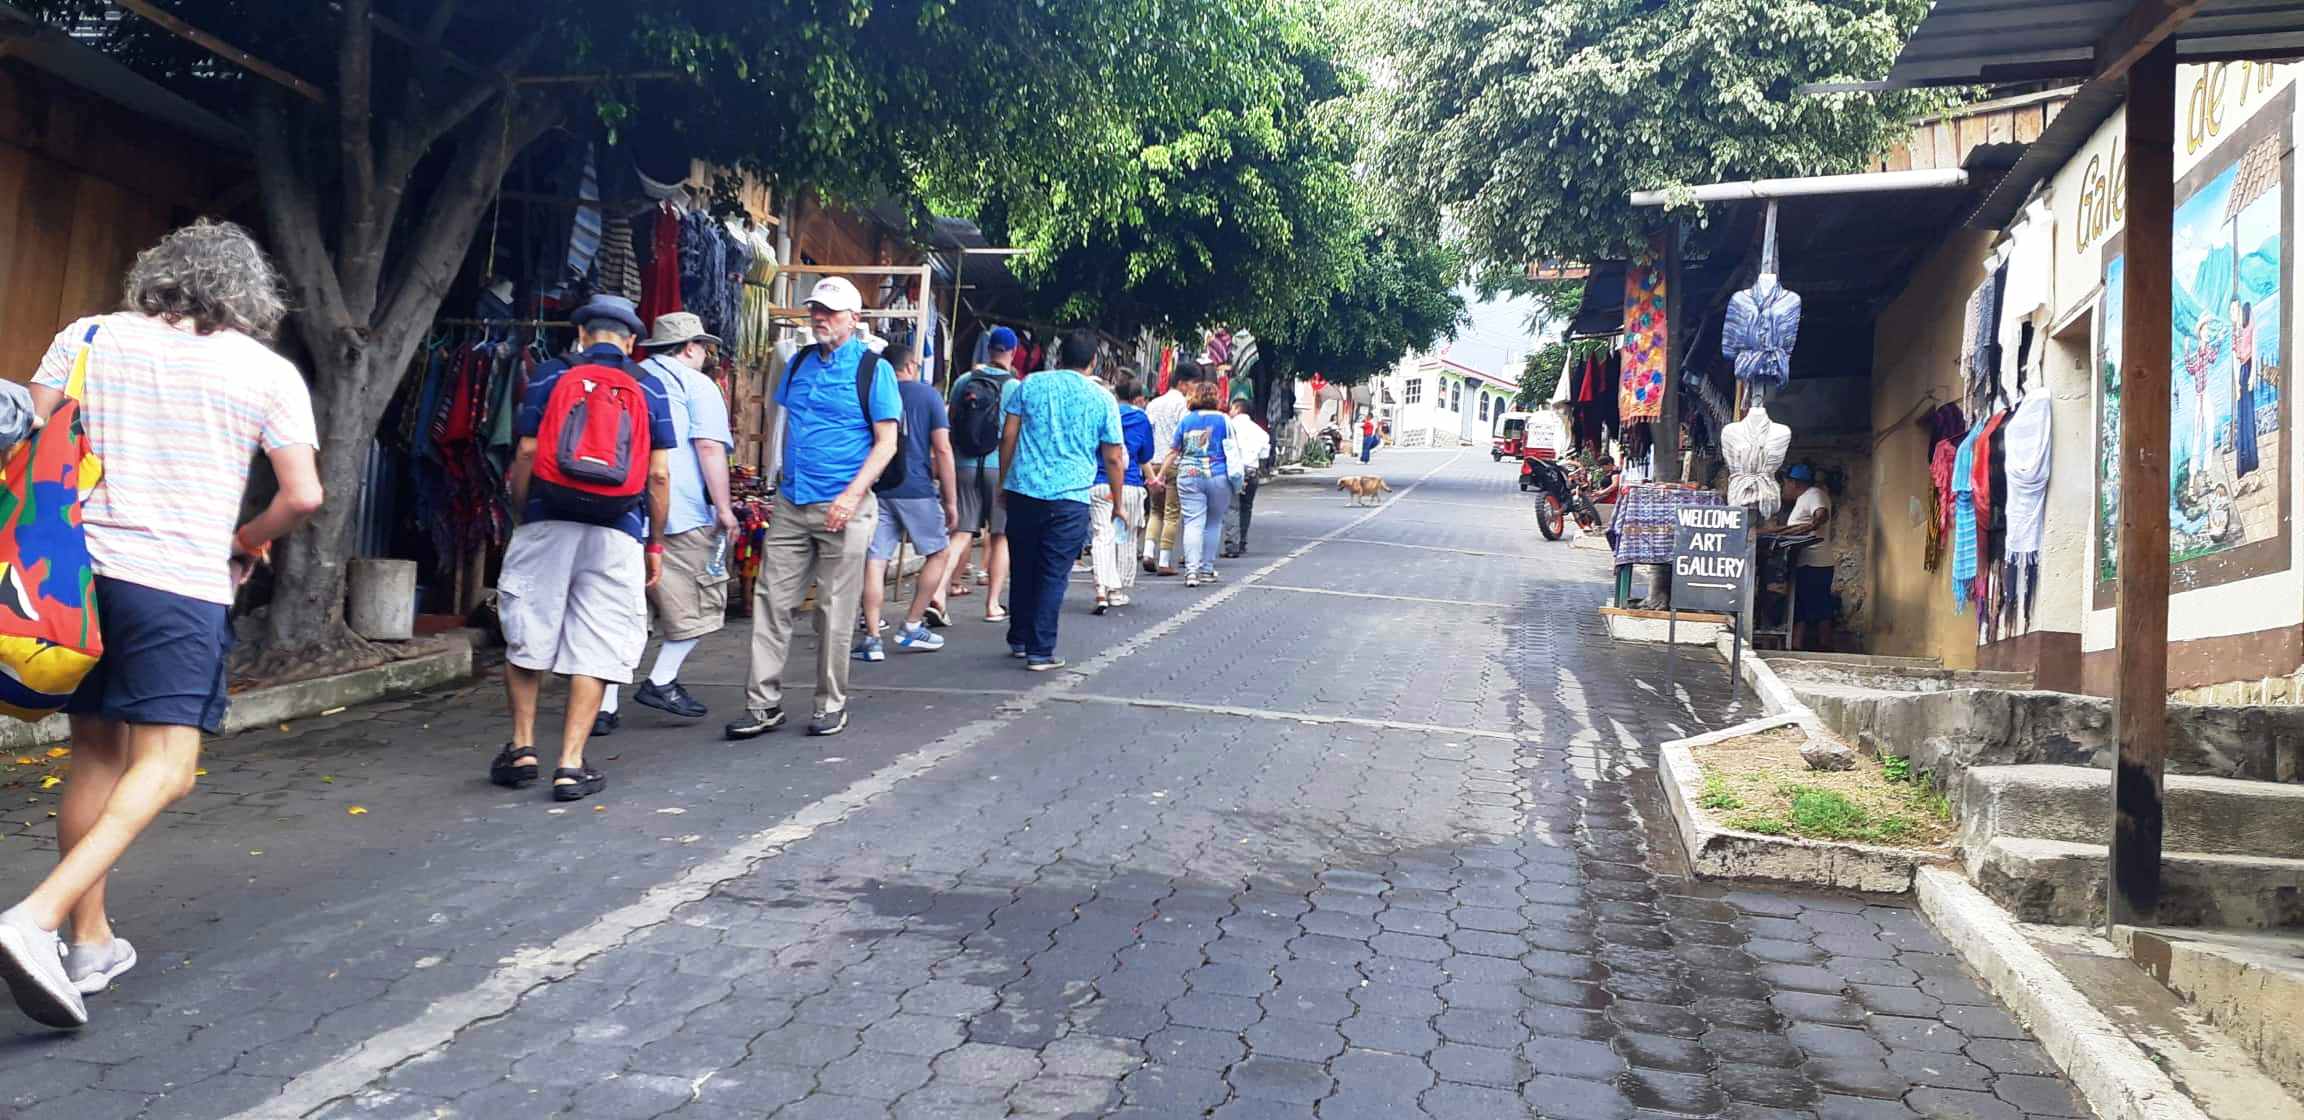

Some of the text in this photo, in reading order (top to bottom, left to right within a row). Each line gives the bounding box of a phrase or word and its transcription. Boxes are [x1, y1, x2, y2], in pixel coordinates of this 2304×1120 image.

[1677, 508, 1742, 529] WELCOME
[1689, 532, 1727, 552] ART
[1676, 555, 1745, 578] GALLERY
